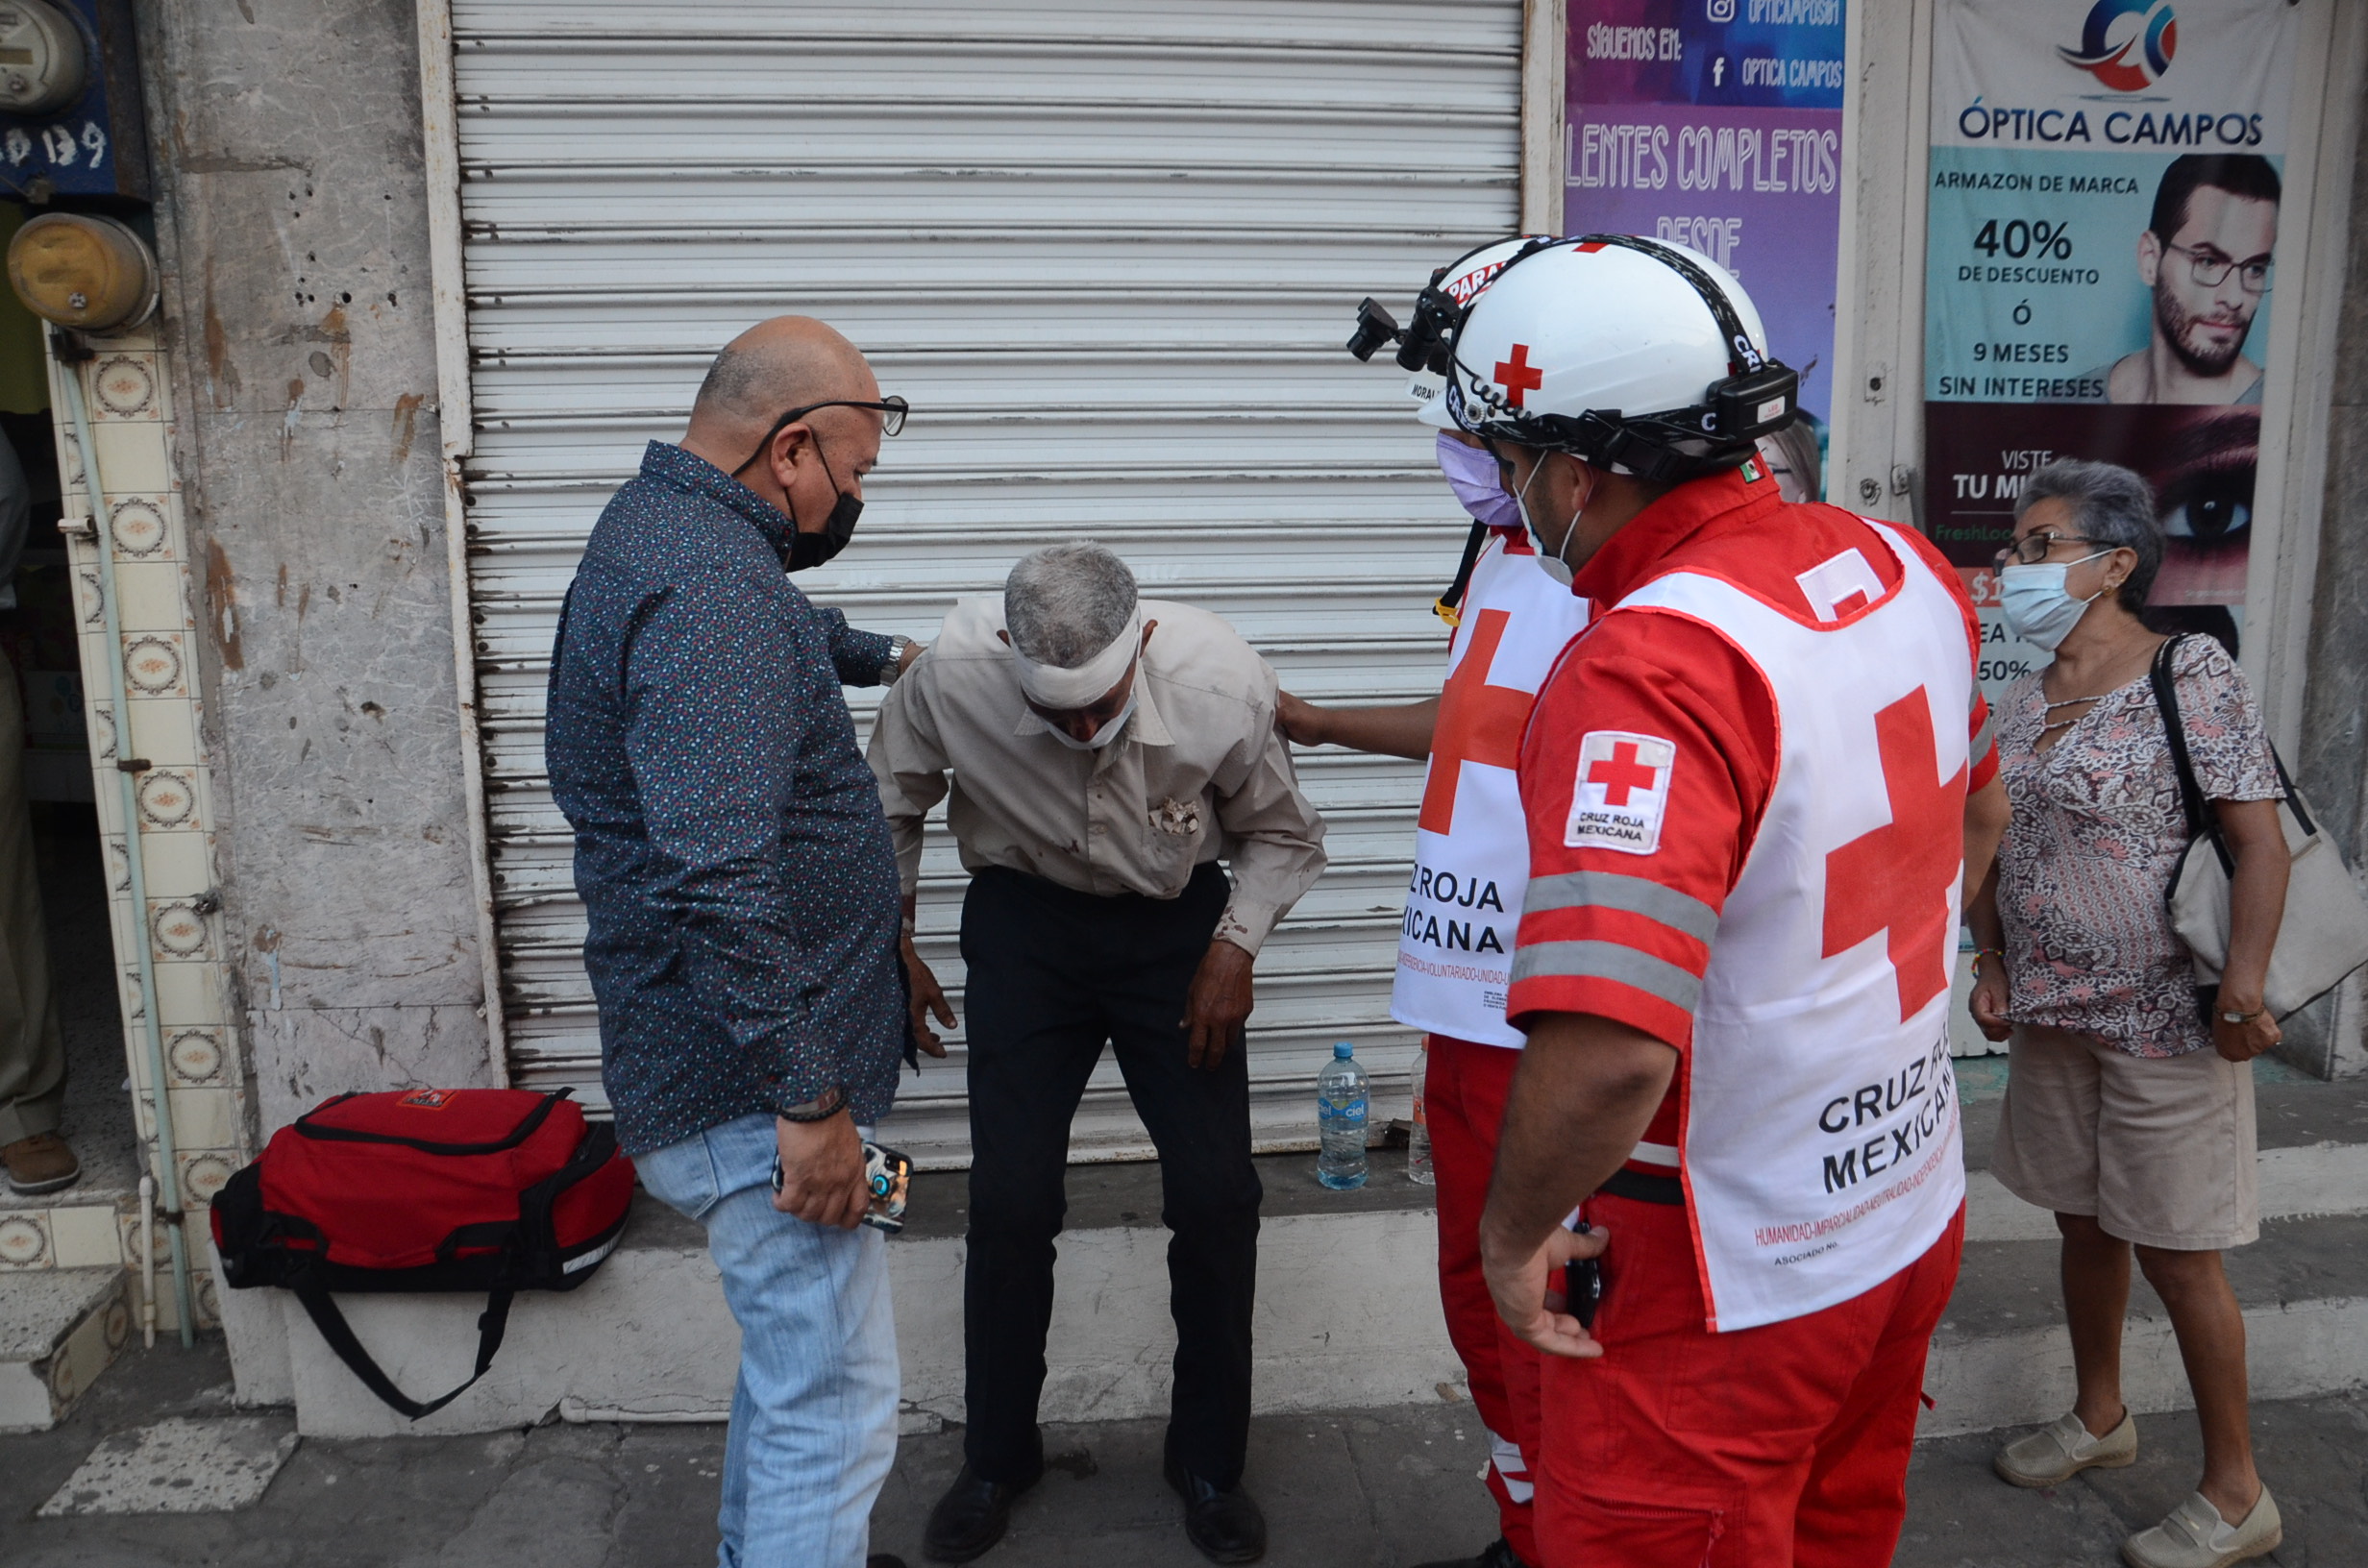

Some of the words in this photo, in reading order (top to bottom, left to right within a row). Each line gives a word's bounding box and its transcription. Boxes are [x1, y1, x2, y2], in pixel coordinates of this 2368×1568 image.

[1587, 21, 1656, 61] SÍGUENOS
[1659, 27, 1682, 61] EN:
[1742, 58, 1786, 86] OPTICA
[1789, 59, 1842, 88] CAMPOS
[1959, 96, 2091, 142] ÓPTICA
[2104, 110, 2263, 146] CAMPOS
[1565, 123, 1669, 190] LENTES
[1677, 125, 1838, 194] COMPLETOS
[1935, 171, 2033, 190] ARMAZON
[2039, 175, 2063, 192] DE
[2069, 176, 2139, 194] MARCA
[1973, 219, 2073, 260] 40%
[1448, 261, 1507, 302] PARA
[1958, 266, 1983, 282] DE
[1987, 267, 2100, 284] DESCUENTO
[1973, 342, 1987, 361] 9
[1993, 343, 2069, 362] MESES
[1938, 377, 1976, 396] SIN
[1984, 378, 2105, 398] INTERESES
[2002, 450, 2053, 470] VISTE
[1953, 474, 1988, 499] TU
[1580, 812, 1610, 823] CRUZ
[1613, 814, 1644, 828] ROJA
[1577, 824, 1642, 842] MEXICANA
[1419, 866, 1505, 913] ROJA
[1818, 1055, 1926, 1134] CRUZ
[1345, 1104, 1365, 1117] ciel
[1774, 1246, 1825, 1266] ASOCIADO
